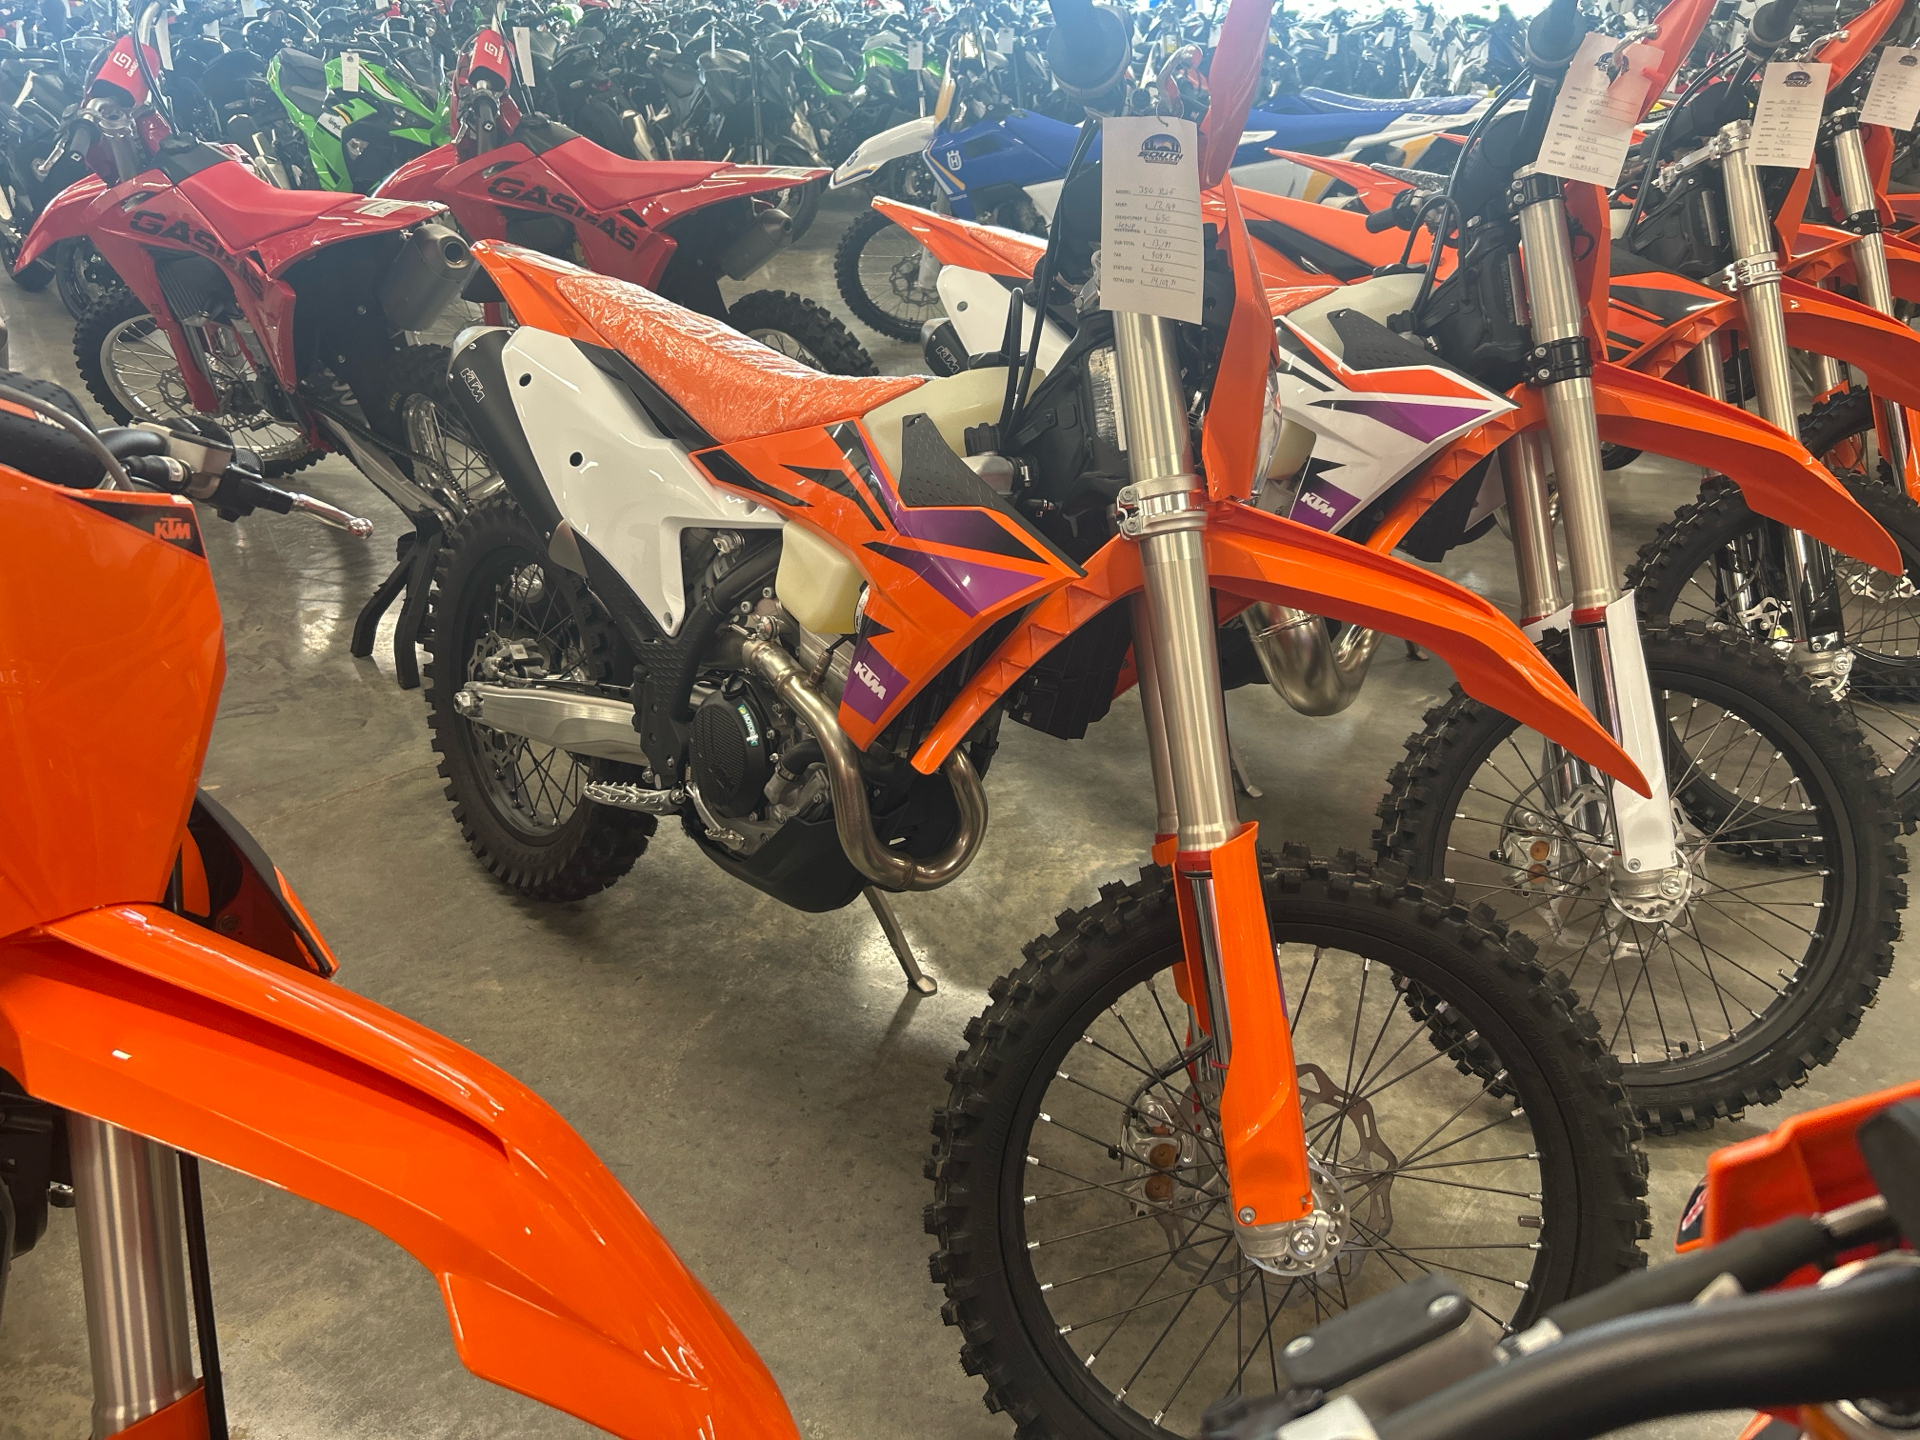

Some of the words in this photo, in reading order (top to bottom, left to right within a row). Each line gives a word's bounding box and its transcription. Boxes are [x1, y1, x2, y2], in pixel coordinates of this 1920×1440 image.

[126, 59, 139, 78] GASG
[1648, 110, 1670, 120] SUZU
[1139, 185, 1154, 194] 350
[1155, 212, 1171, 222] 650
[1154, 226, 1168, 235] 200
[935, 345, 960, 374] KTM
[460, 367, 486, 403] KTM
[1300, 492, 1336, 518] KTM
[154, 517, 191, 540] KTM
[853, 661, 887, 700] KTM
[743, 713, 759, 744] MOTORX
